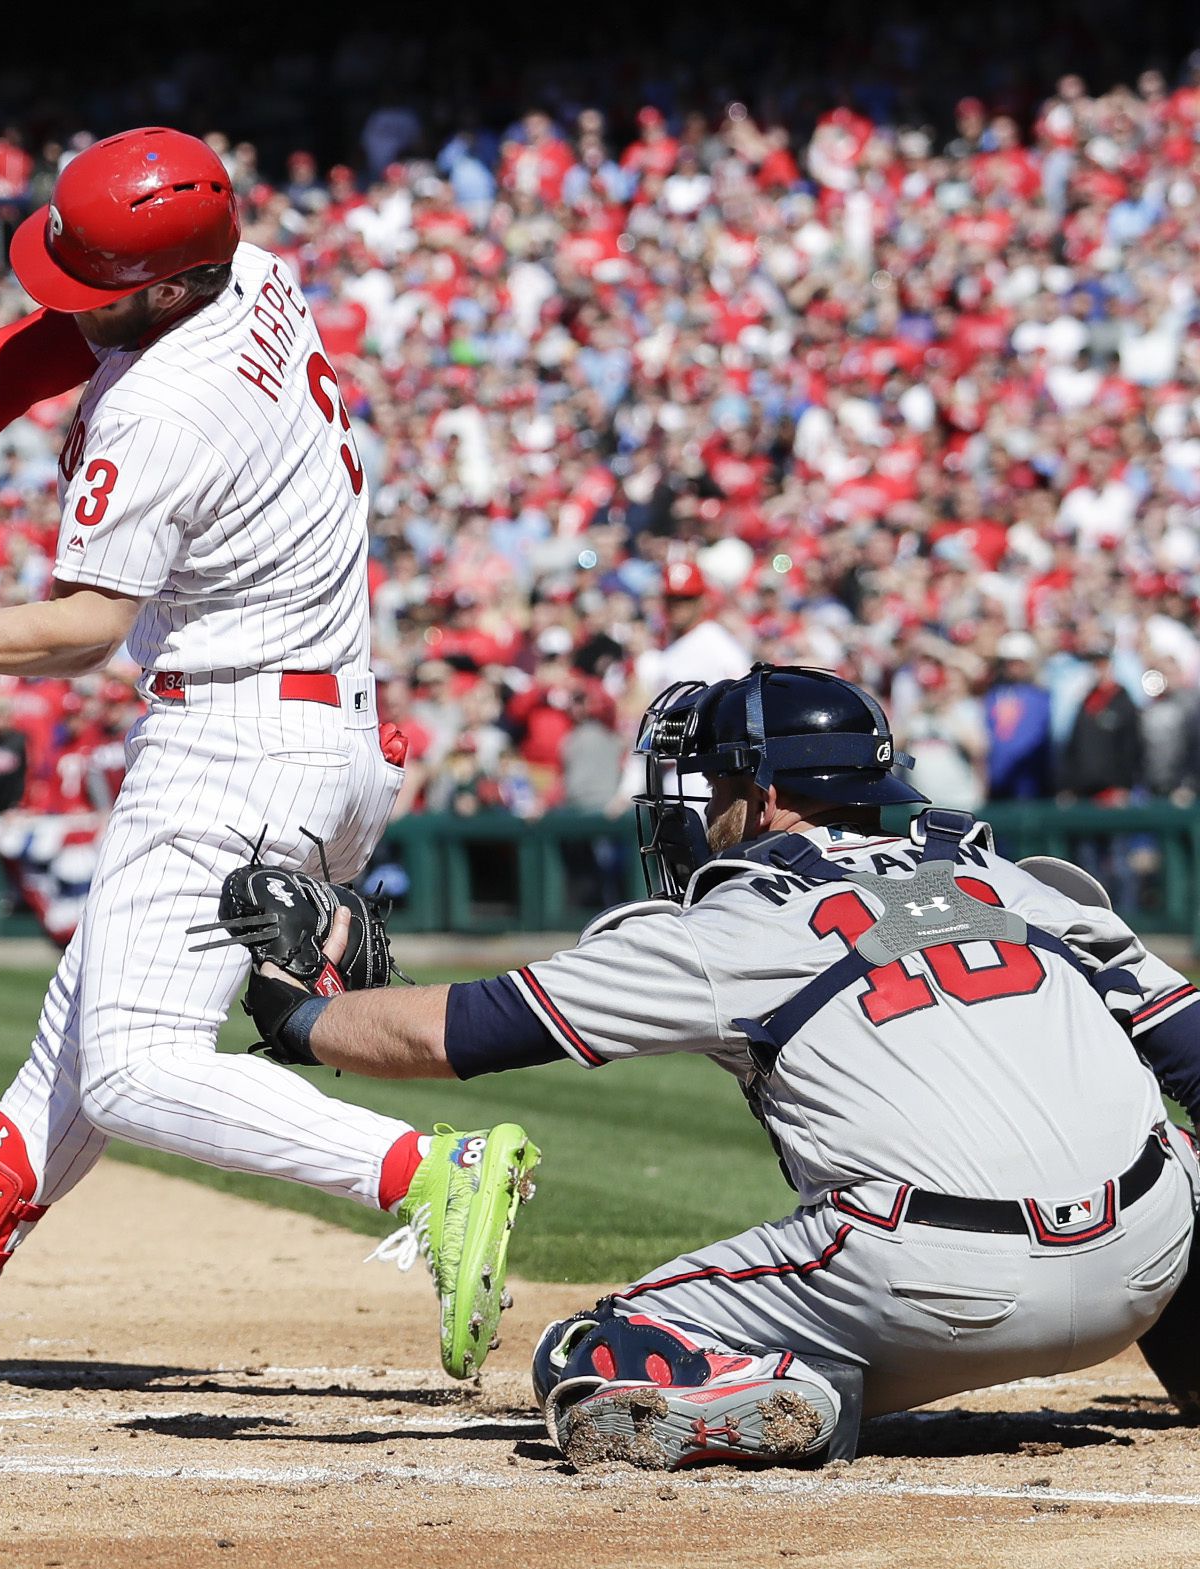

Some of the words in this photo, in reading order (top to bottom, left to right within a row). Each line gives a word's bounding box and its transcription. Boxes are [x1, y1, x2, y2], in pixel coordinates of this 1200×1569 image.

[237, 256, 306, 403] HARPE
[74, 458, 119, 527] 3
[166, 674, 185, 690] 34
